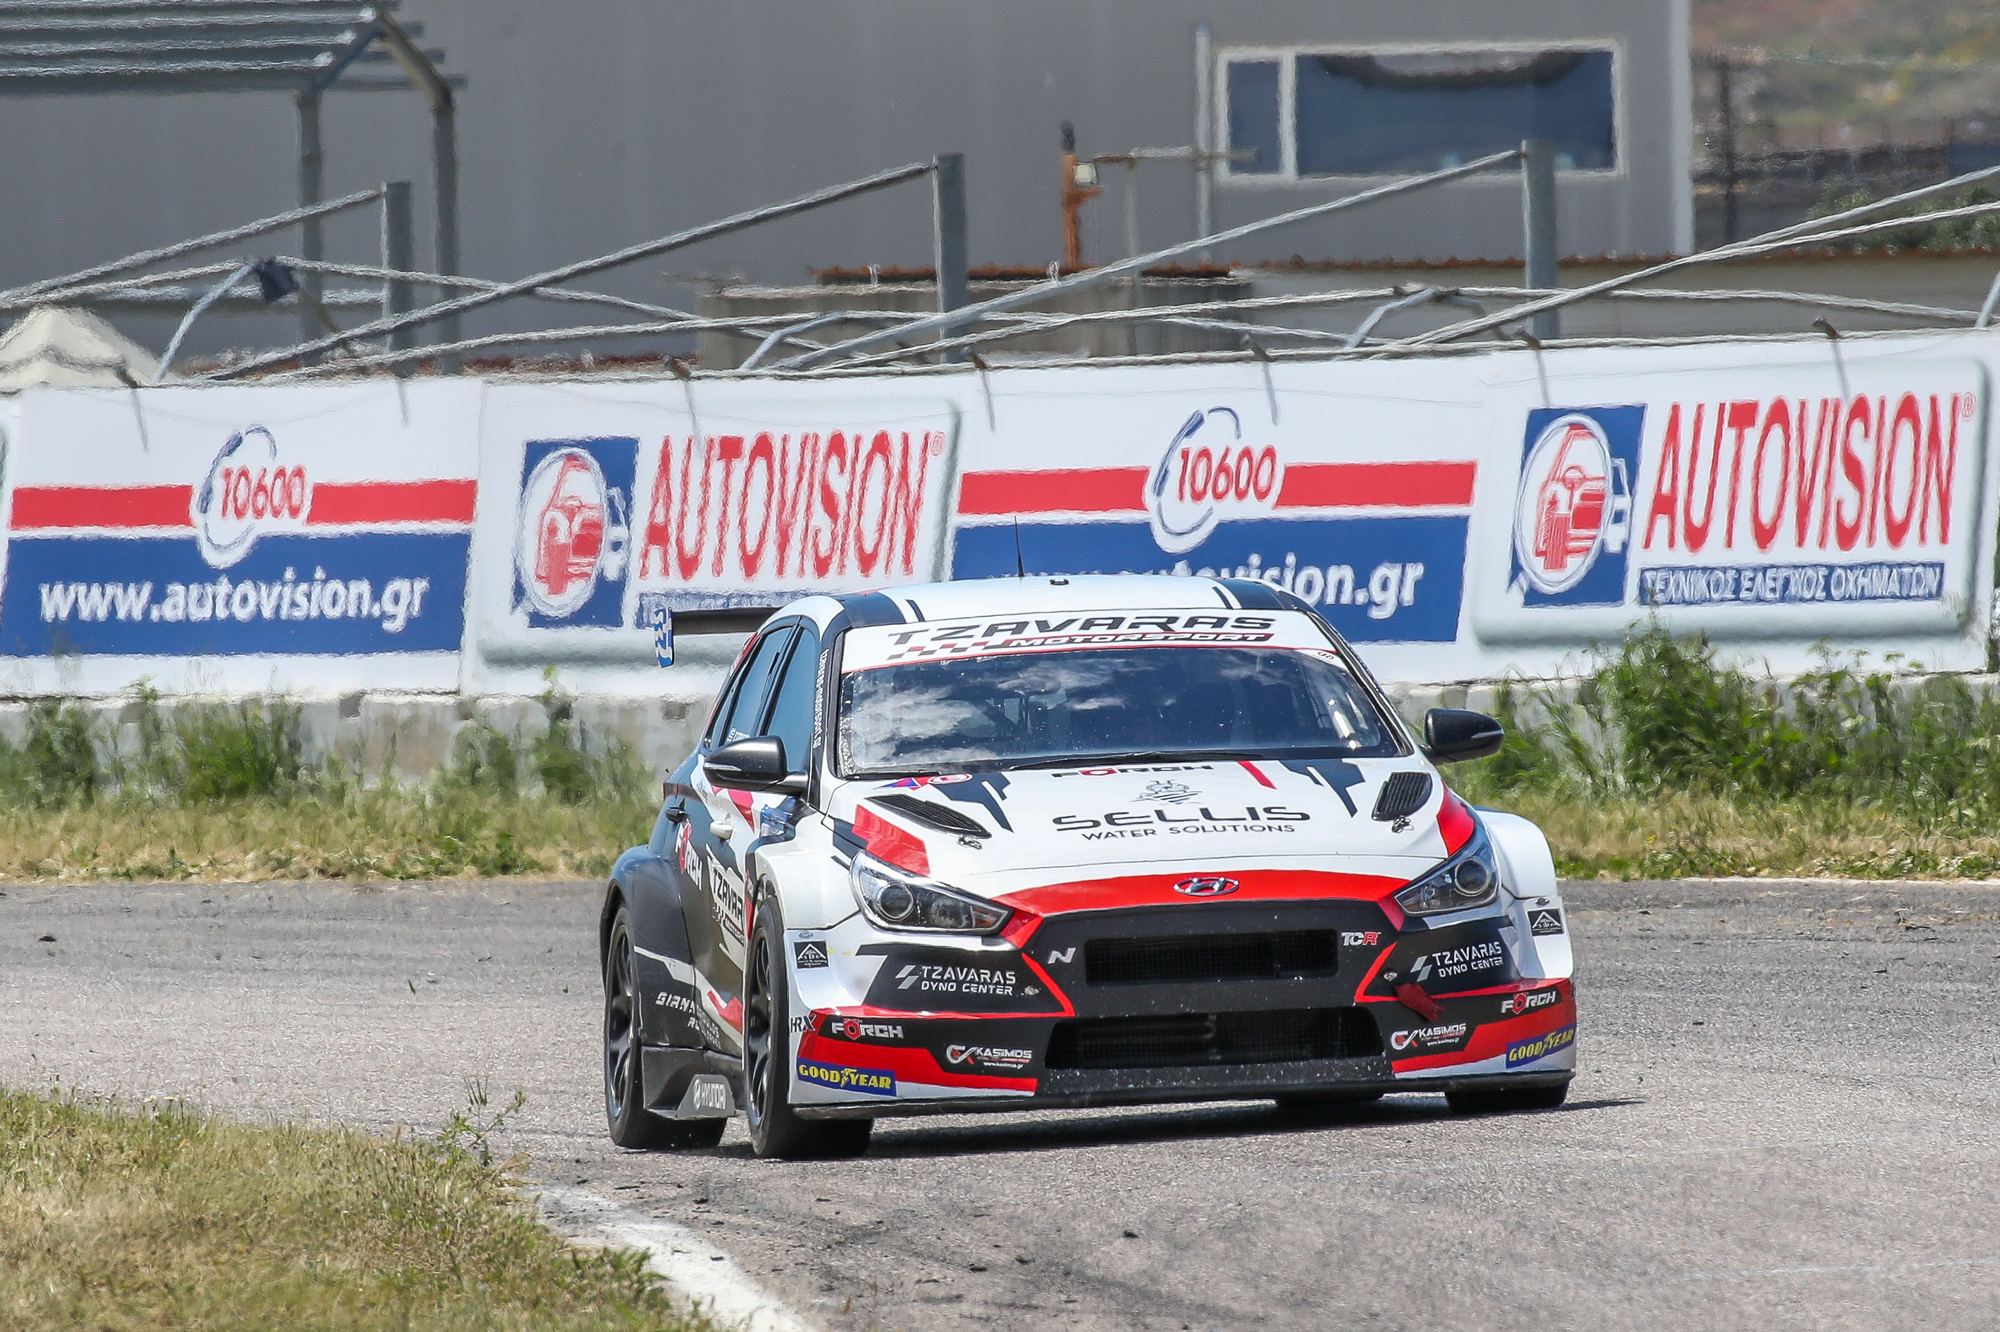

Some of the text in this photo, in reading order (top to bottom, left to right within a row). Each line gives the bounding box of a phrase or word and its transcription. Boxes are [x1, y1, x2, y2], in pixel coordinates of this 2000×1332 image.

[1178, 444, 1277, 505] 10600
[221, 465, 306, 521] 10600
[39, 566, 431, 634] www.autovision.gr
[887, 615, 1276, 647] TZAVARAS
[1007, 631, 1271, 648] MOTORSPORT
[1052, 806, 1311, 833] SELLIS
[1080, 823, 1296, 841] WATER SOLUTIONS
[1341, 931, 1377, 946] TCR
[1432, 941, 1502, 965] TZAVARAS
[921, 965, 1016, 985] TZAVARAS
[1438, 957, 1503, 979] DYNO CENTER
[921, 980, 1014, 996] DYNO CENTER
[790, 1015, 816, 1033] HRX
